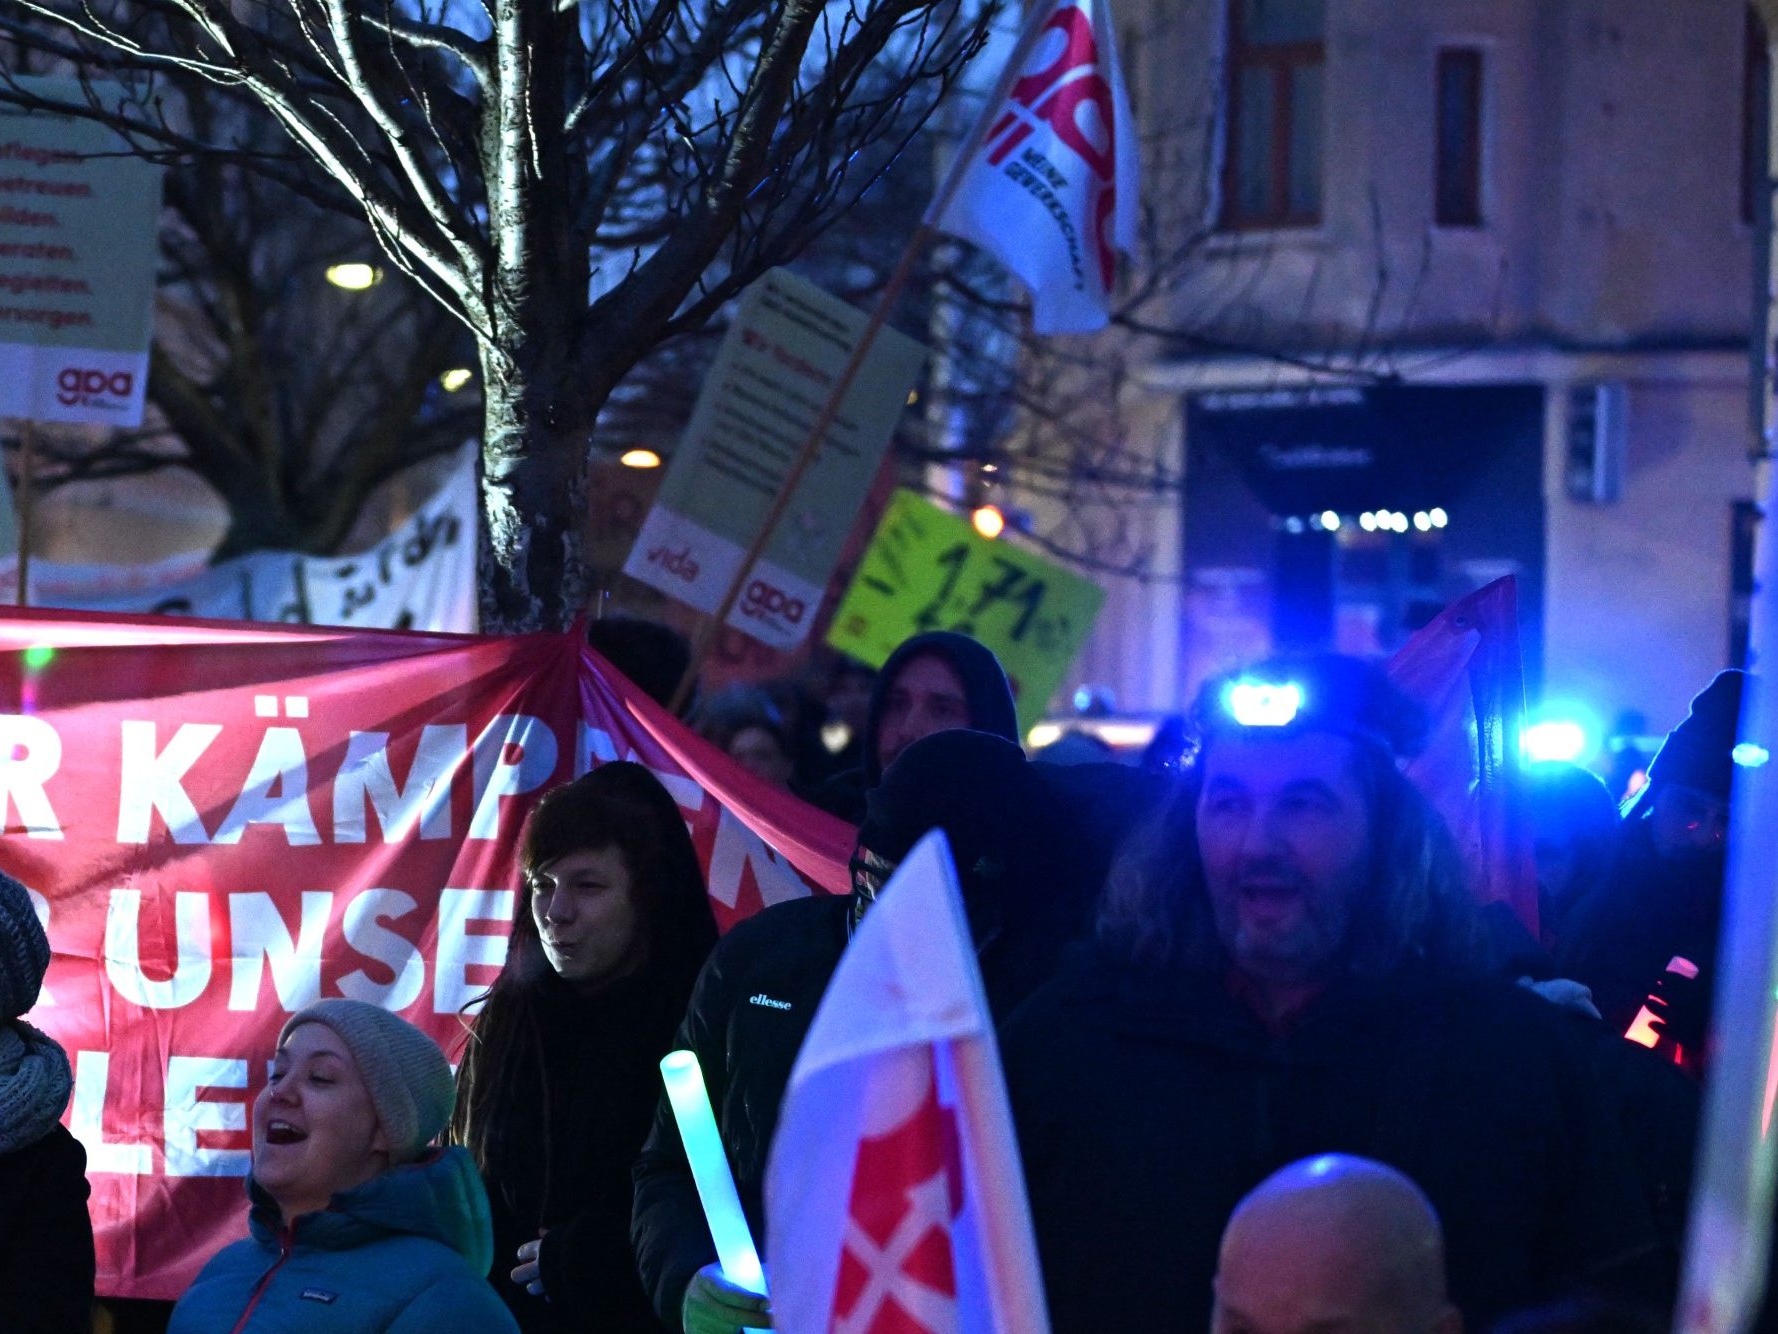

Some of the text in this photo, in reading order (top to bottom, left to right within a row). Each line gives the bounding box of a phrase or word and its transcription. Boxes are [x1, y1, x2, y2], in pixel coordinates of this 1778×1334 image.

[1021, 147, 1069, 190] MEINE
[57, 367, 134, 406] gpa
[647, 548, 701, 582] vida
[739, 579, 805, 625] gpa
[749, 993, 792, 1011] ellesse
